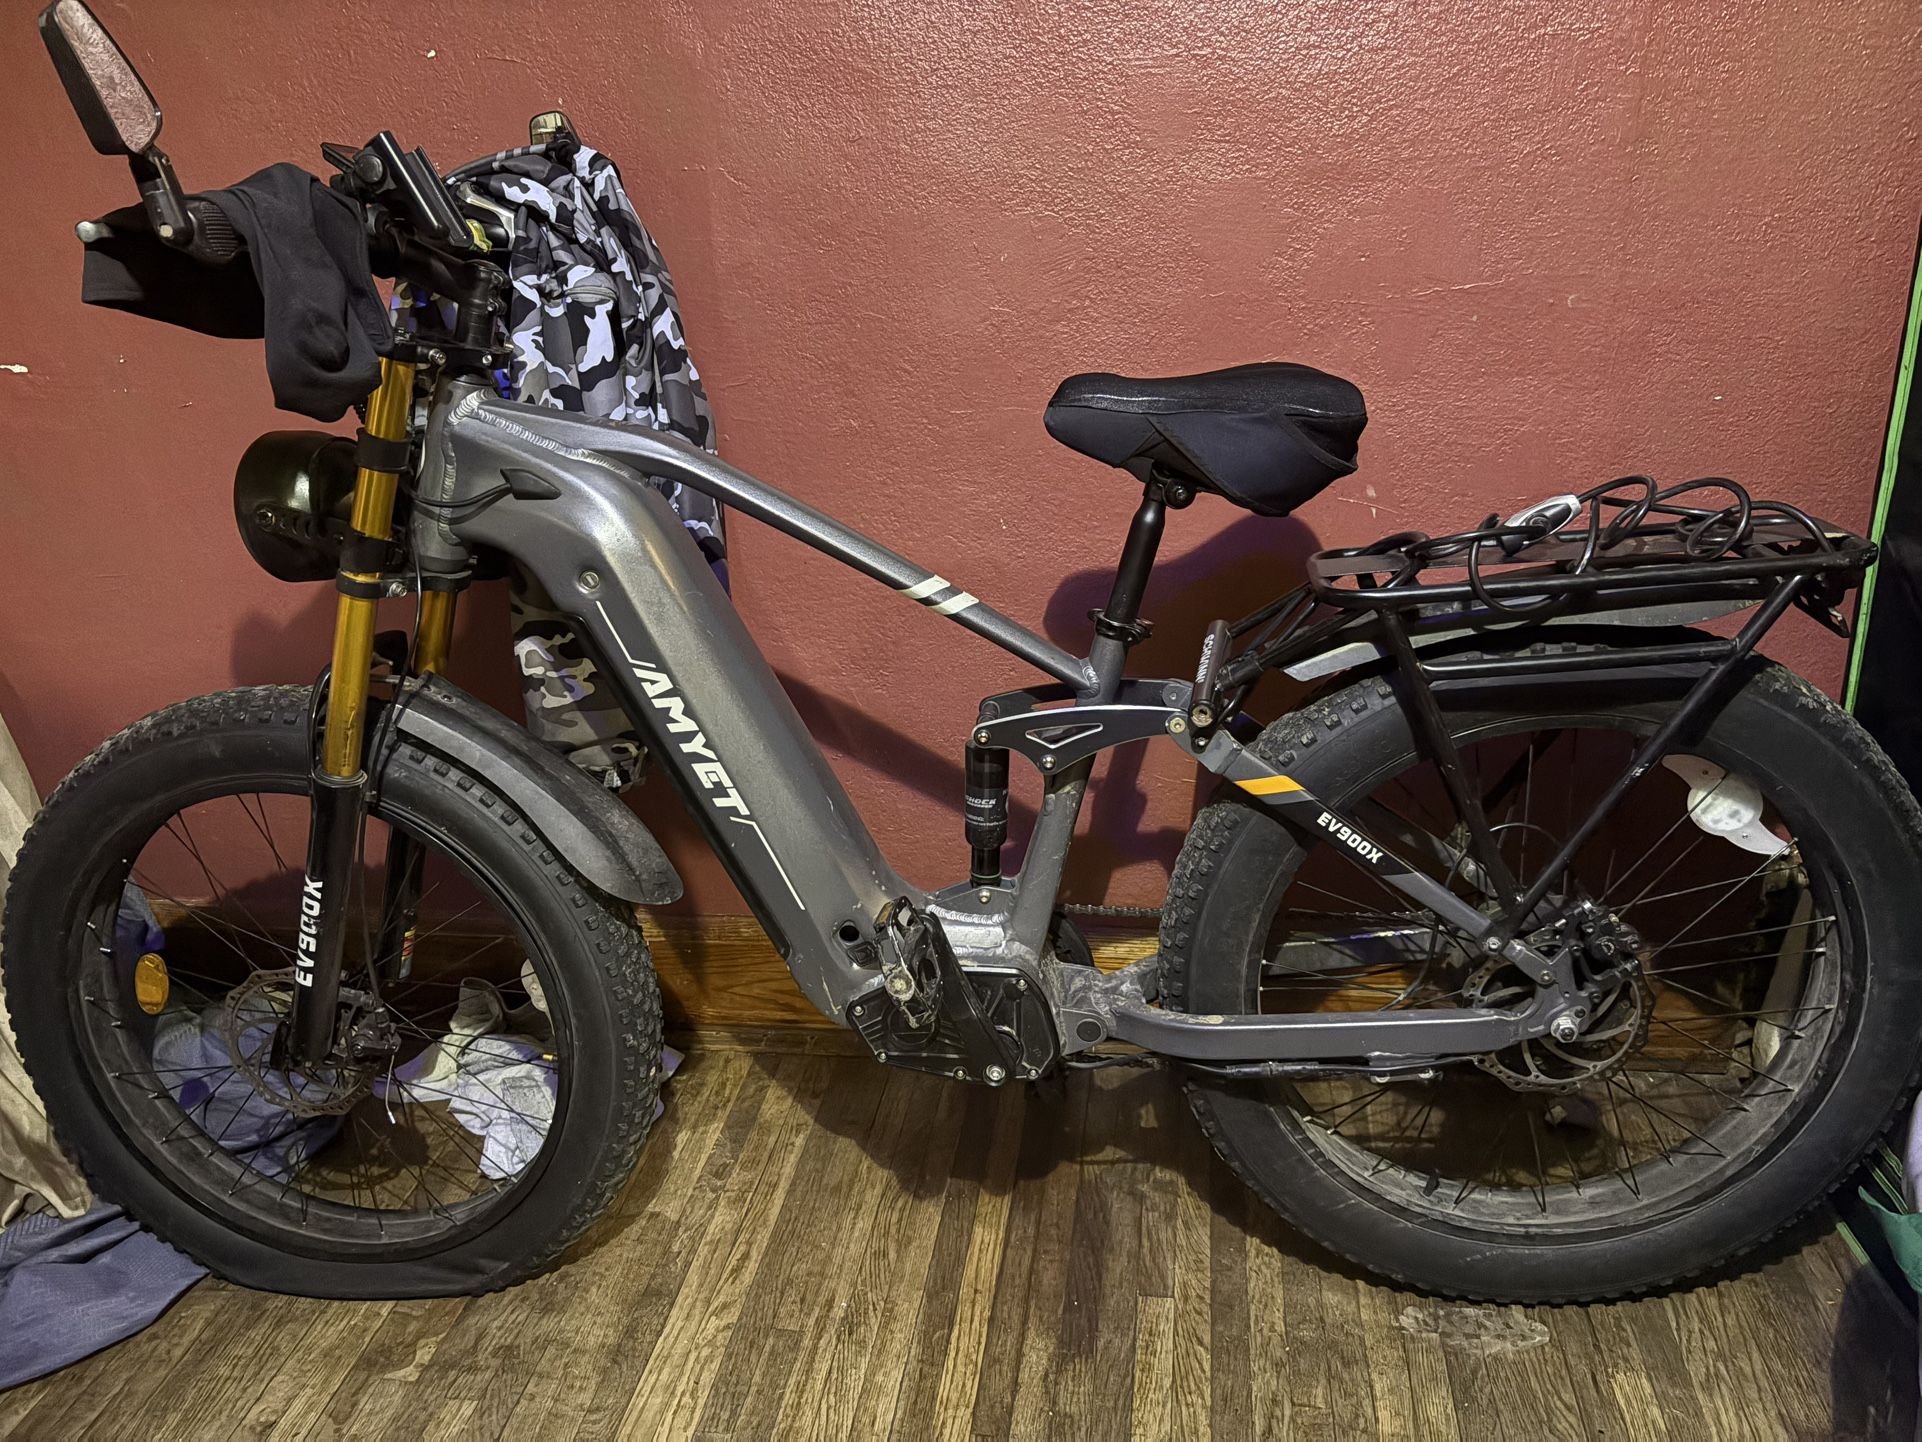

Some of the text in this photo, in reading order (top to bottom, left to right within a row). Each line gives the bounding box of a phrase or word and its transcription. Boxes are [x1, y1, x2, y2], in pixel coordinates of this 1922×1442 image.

[632, 667, 750, 815] AMYET
[1317, 811, 1384, 864] EV900X
[295, 874, 323, 988] EV900X
